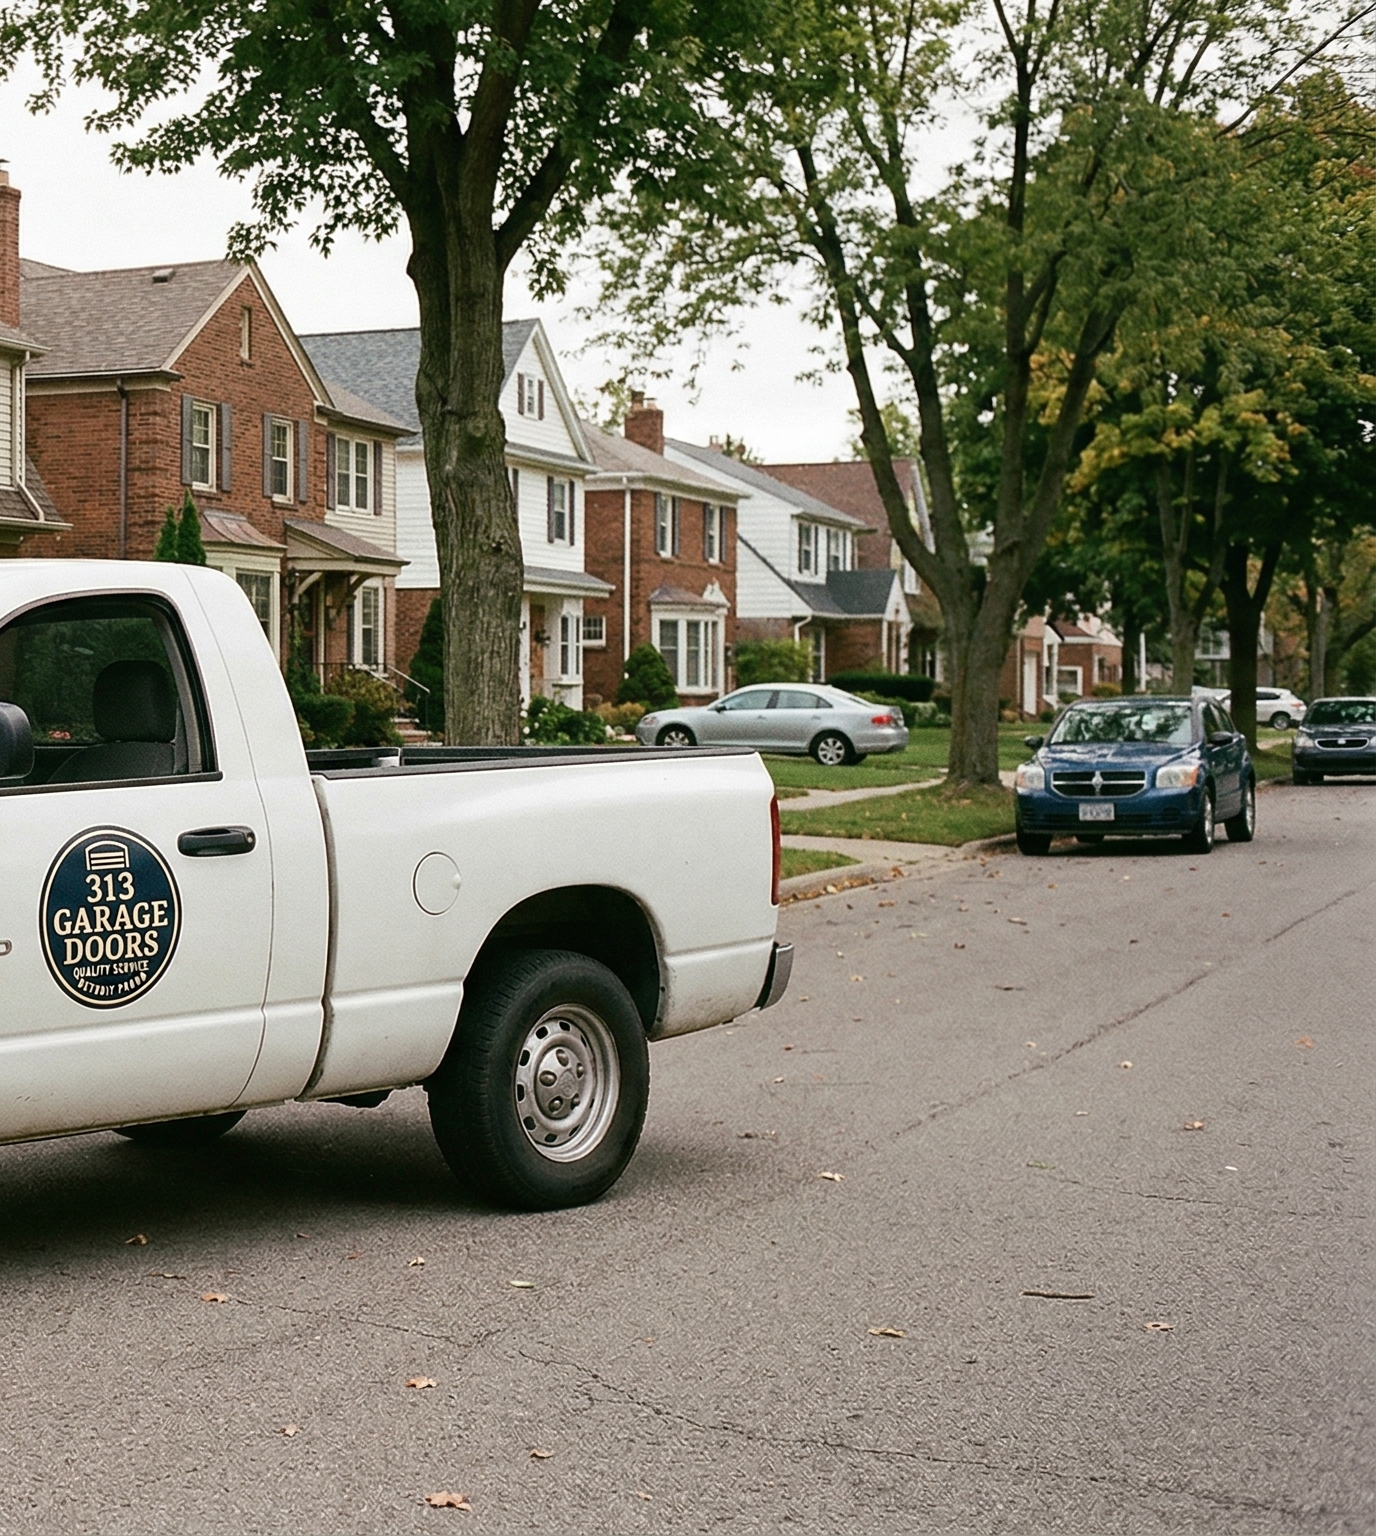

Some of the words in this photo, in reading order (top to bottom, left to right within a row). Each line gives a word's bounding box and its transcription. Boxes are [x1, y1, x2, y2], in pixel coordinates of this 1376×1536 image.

[85, 871, 135, 903] 313
[53, 900, 169, 936] GARAGE
[63, 930, 159, 965] DOORS
[73, 964, 110, 980] QUALITY
